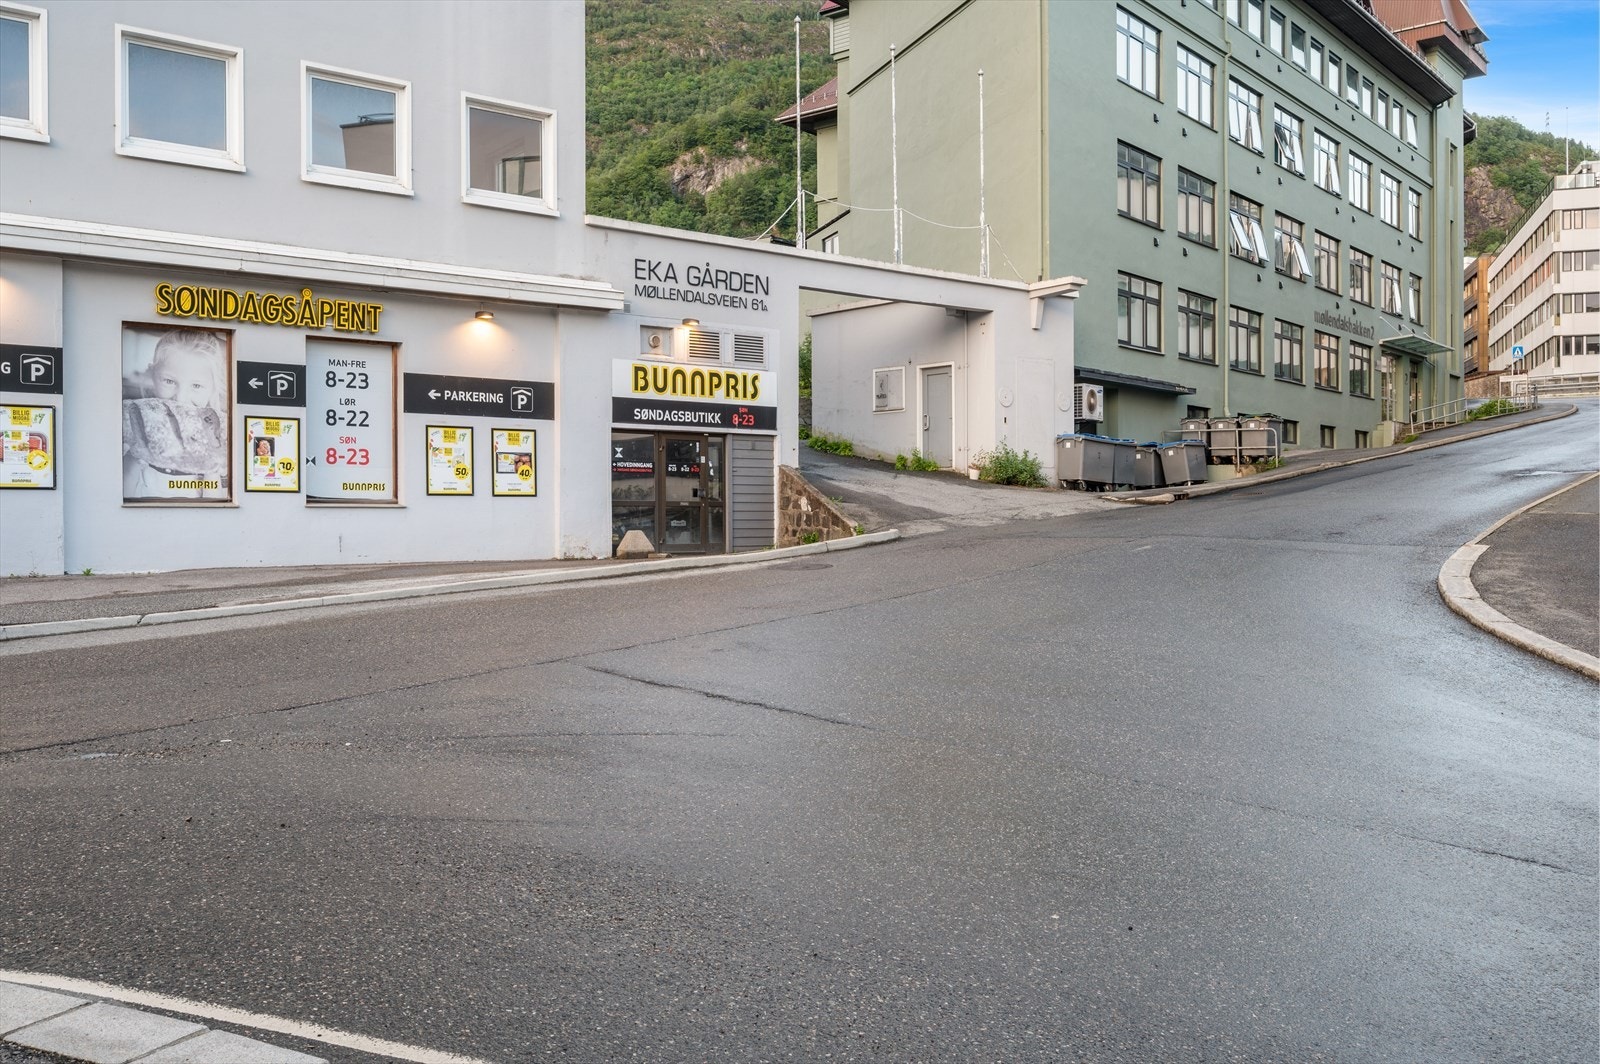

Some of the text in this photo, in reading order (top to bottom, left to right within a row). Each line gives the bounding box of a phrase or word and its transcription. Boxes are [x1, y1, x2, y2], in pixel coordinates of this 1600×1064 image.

[634, 258, 769, 295] EKA GÅRDEN
[634, 284, 748, 309] MØLLENDALSVEIEN
[155, 282, 383, 333] SØNDAGSÅPENT
[1370, 325, 1375, 340] 2
[328, 359, 367, 369] MAN-FRE
[325, 371, 369, 390] 8-23
[632, 363, 760, 401] BUNNPRIS
[339, 398, 356, 406] LØR
[444, 390, 504, 404] PARKERING
[325, 409, 370, 427] 8-22
[633, 408, 755, 427] SØNDAGSBUTIKK 8-23
[339, 436, 357, 444] SØN
[325, 447, 370, 466] 8-23
[168, 480, 218, 489] BUNNPRIS
[342, 483, 386, 491] BUNNPRIS
